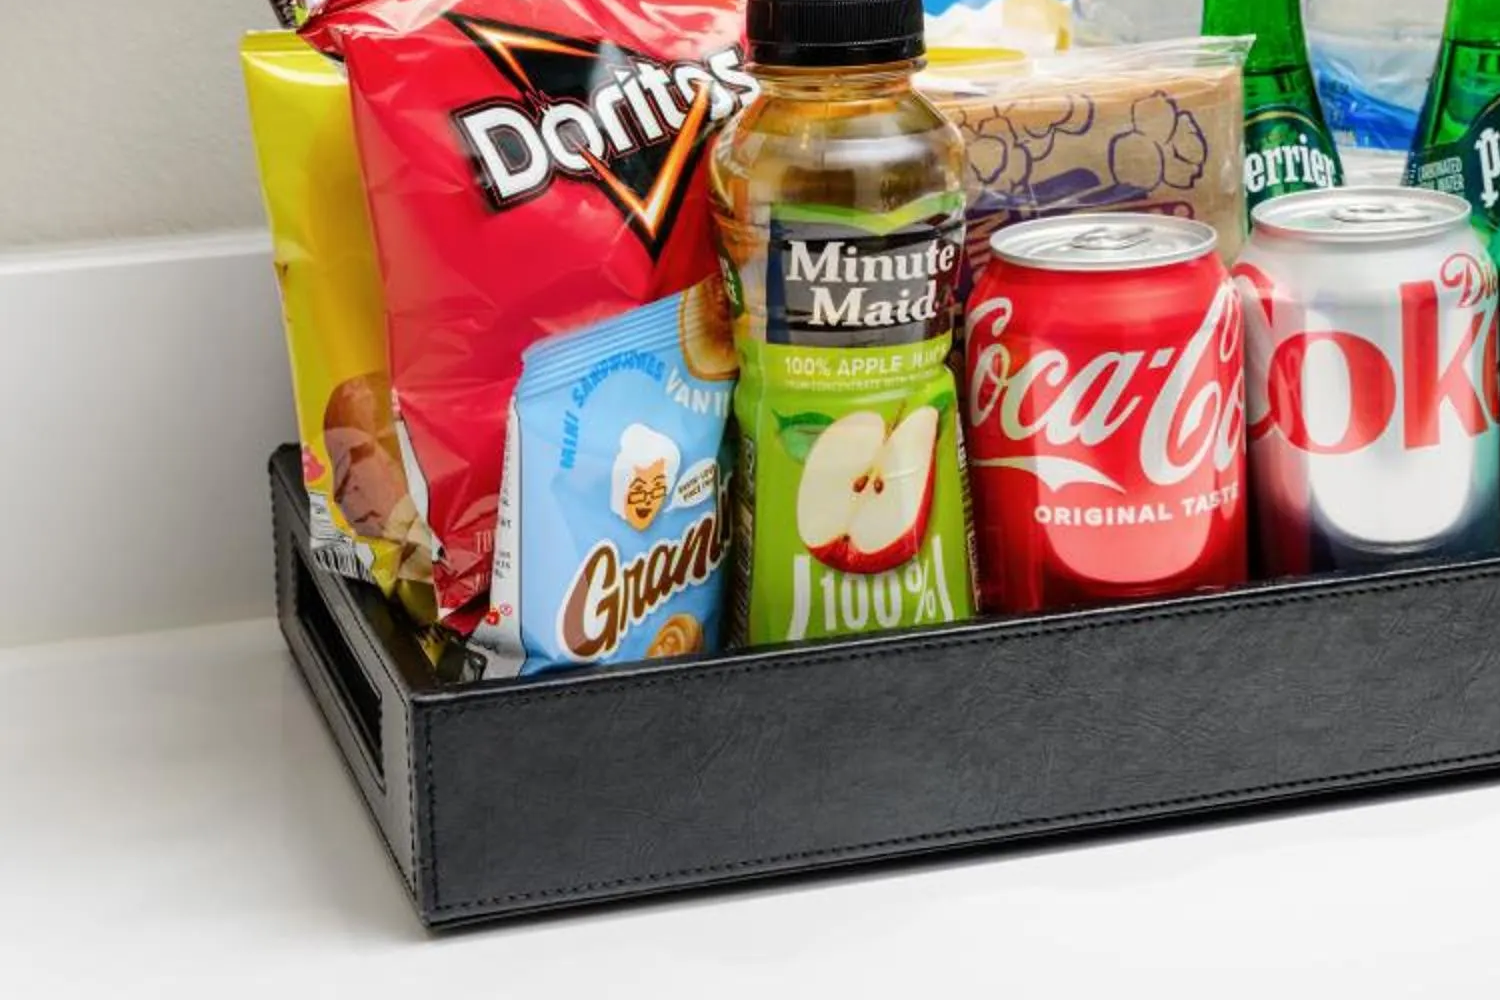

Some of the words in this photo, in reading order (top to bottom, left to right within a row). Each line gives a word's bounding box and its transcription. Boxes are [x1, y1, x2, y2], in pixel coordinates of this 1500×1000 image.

[462, 47, 761, 199] Doritos
[1244, 134, 1337, 195] errier
[785, 239, 955, 284] Minute
[808, 287, 938, 328] Maid
[785, 356, 831, 377] 100%
[837, 355, 903, 377] APPLE
[560, 410, 579, 469] MINI
[666, 366, 729, 417] VANI
[1034, 505, 1172, 526] ORIGINAL
[820, 558, 936, 633] 100%
